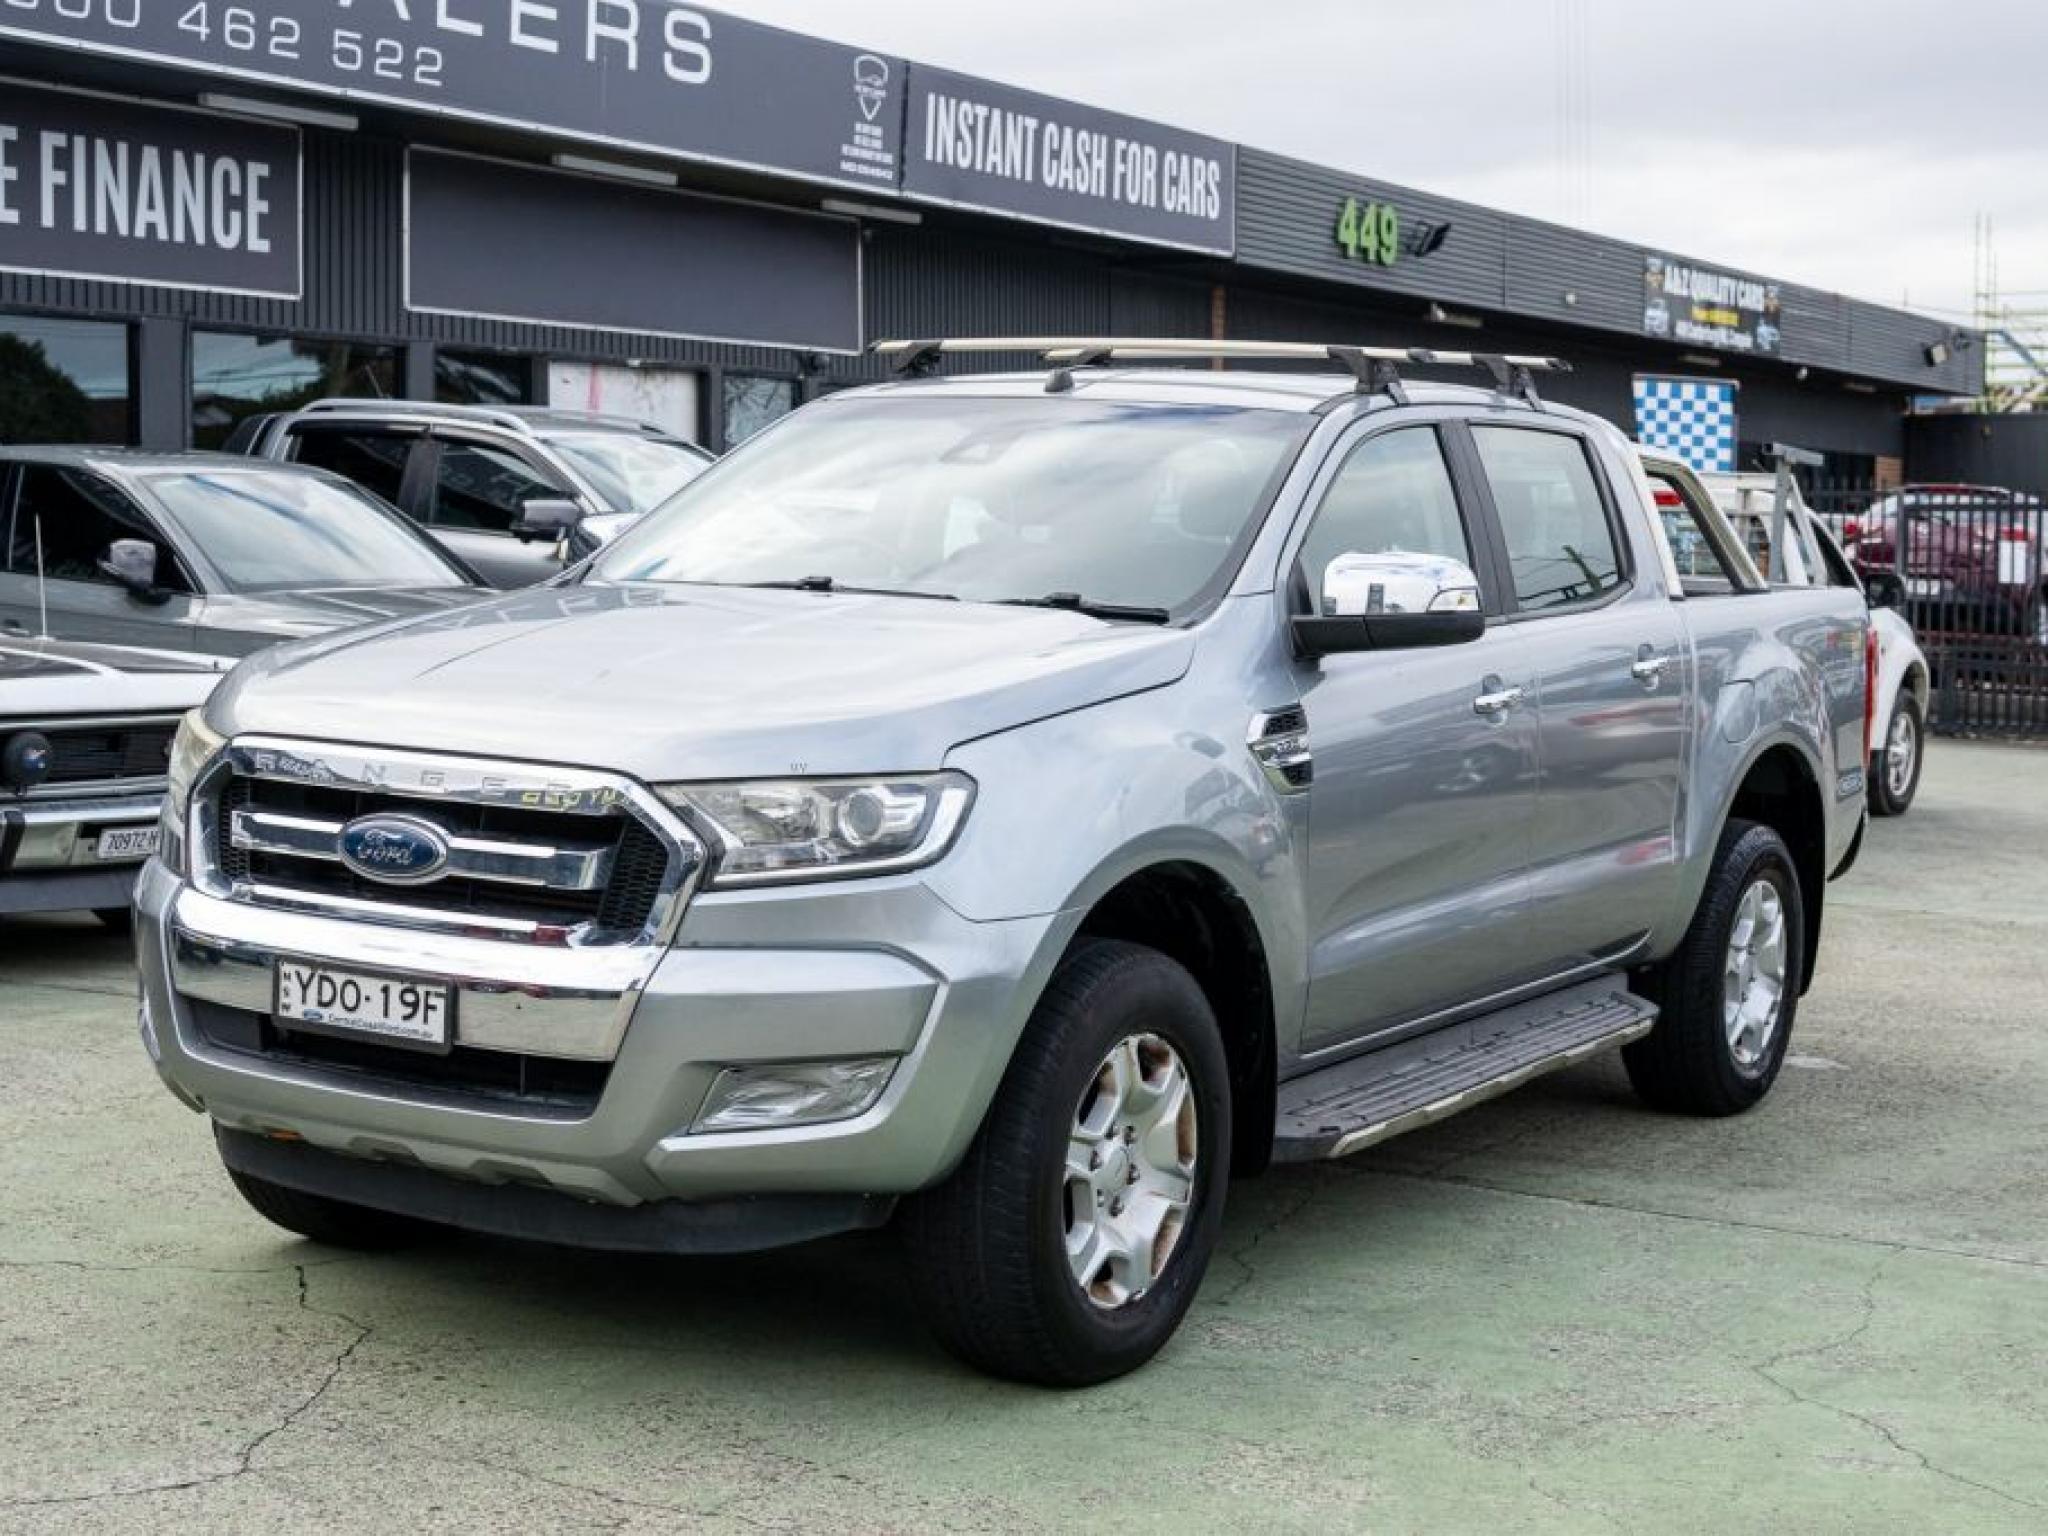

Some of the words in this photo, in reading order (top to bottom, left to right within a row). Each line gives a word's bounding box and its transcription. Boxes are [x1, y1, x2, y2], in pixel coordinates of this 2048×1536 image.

[178, 1, 300, 58] 462
[332, 29, 442, 86] 522
[336, 0, 711, 84] LERS
[40, 131, 270, 252] FINANCE
[926, 92, 1039, 181] INSTANT
[1042, 121, 1107, 198] CASH
[1112, 138, 1157, 207] FOR
[1163, 151, 1220, 220] CARS
[1338, 197, 1398, 265] 449
